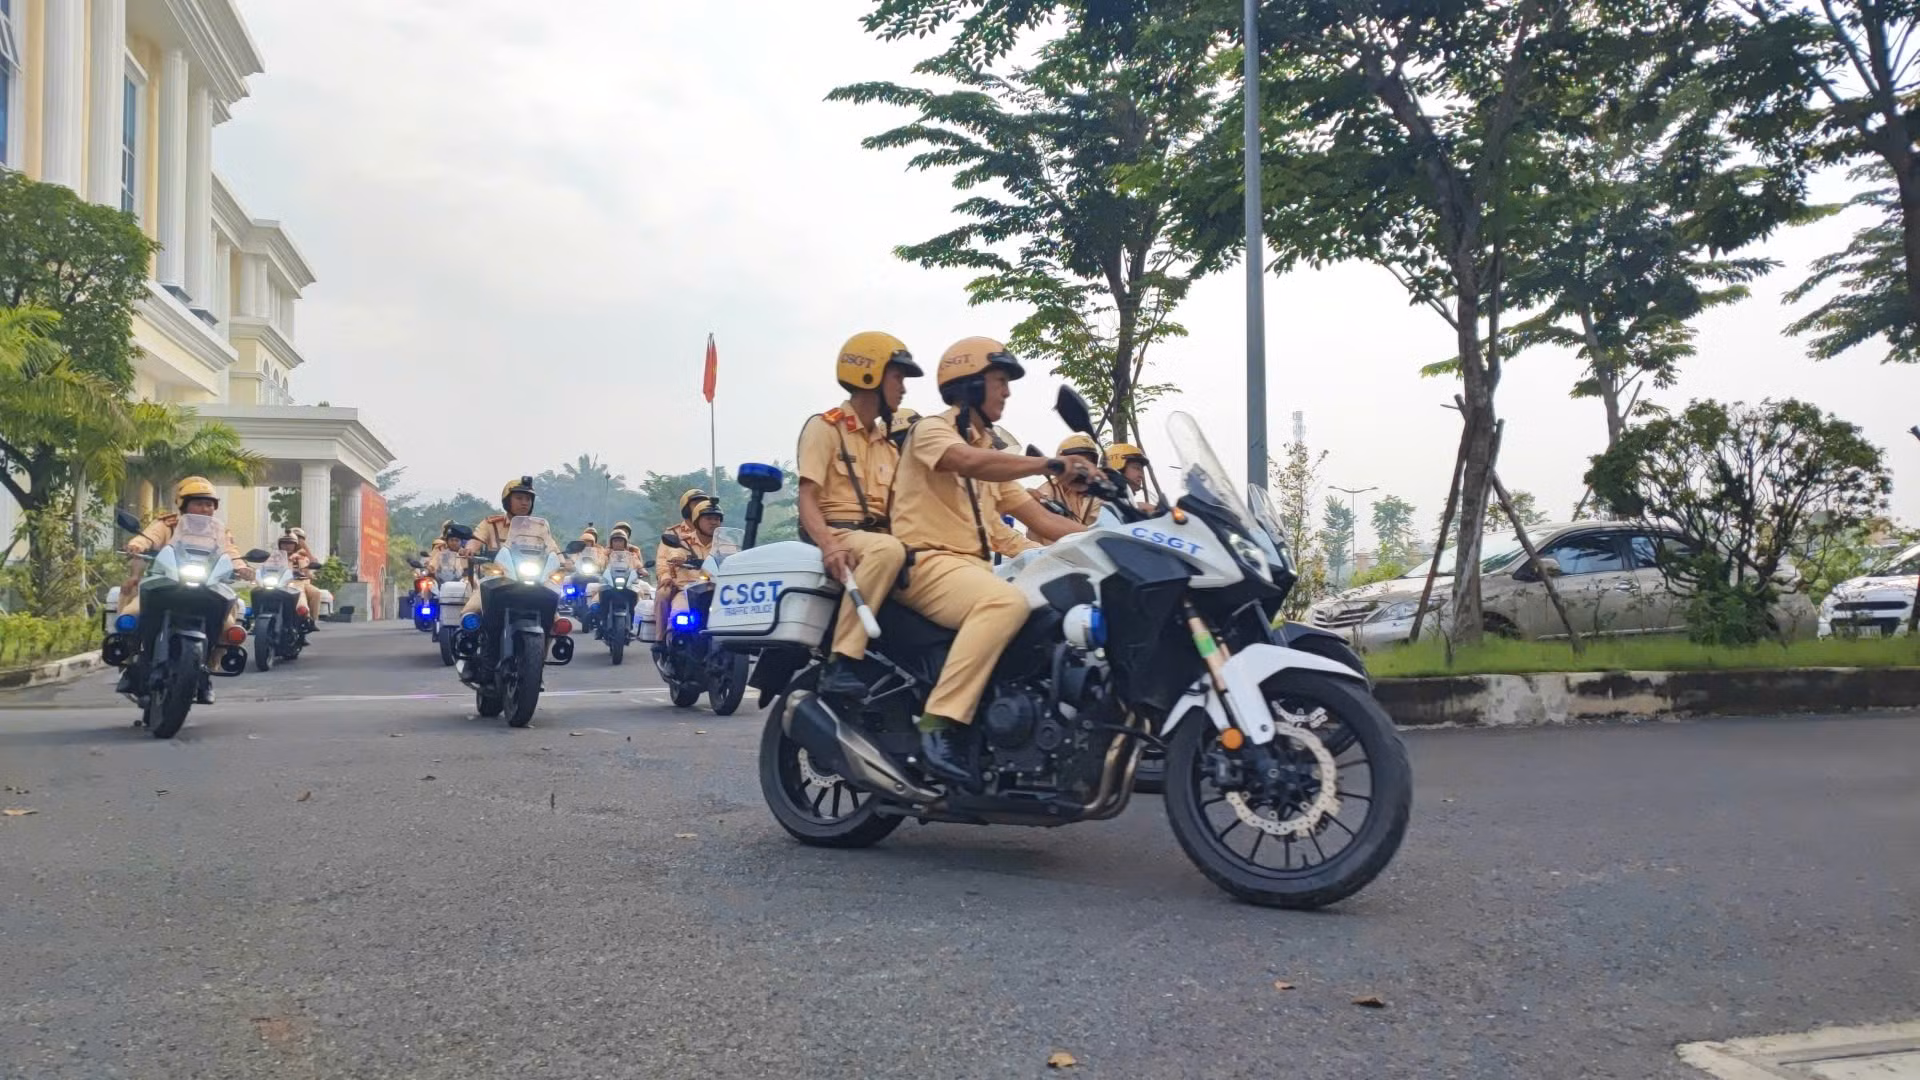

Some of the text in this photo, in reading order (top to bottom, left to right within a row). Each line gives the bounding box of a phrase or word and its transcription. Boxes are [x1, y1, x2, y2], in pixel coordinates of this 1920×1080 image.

[1132, 527, 1203, 555] CSGT
[724, 604, 773, 616] TRAFFIC POLICE
